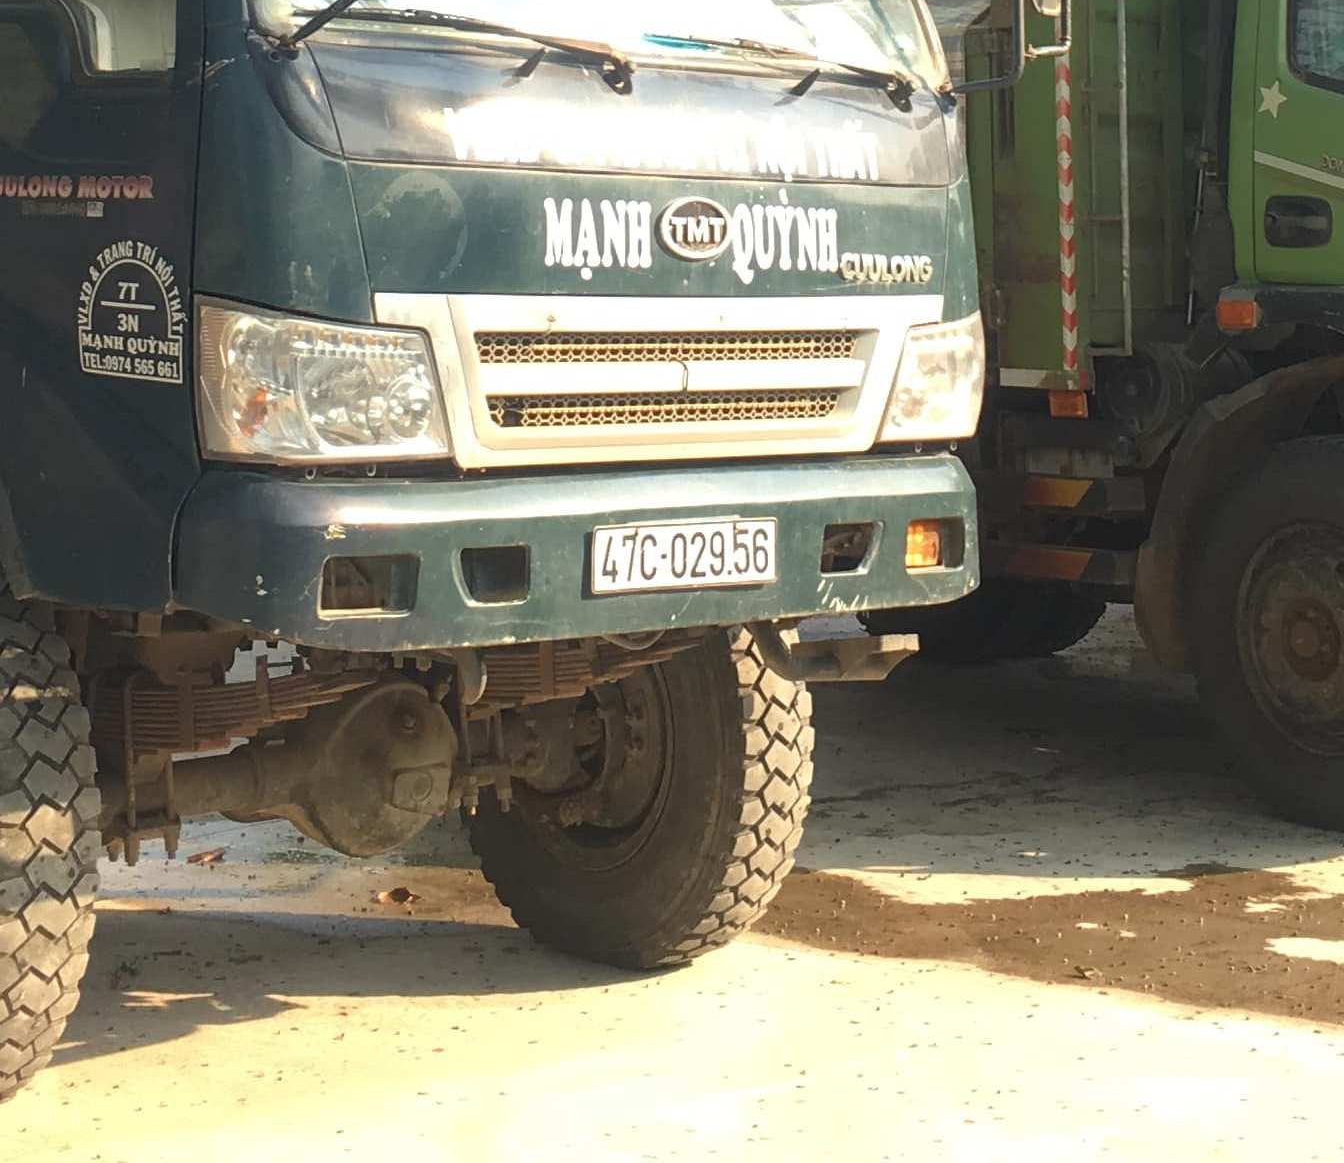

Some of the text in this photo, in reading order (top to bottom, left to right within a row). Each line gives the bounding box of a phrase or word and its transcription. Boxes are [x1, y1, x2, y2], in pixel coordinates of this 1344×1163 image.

[77, 175, 154, 199] MOTOR
[544, 188, 838, 285] MẠNH QUỲNH
[669, 215, 725, 245] TMT
[78, 282, 93, 324] VLXD
[97, 240, 134, 269] TRANG
[136, 241, 159, 265] TRÍ
[118, 281, 139, 300] 7T
[117, 313, 139, 332] 3N
[81, 332, 179, 356] MẠNH QUỲNH
[134, 358, 155, 375] 565
[157, 360, 178, 378] 661
[602, 528, 769, 583] 47C-029.56
